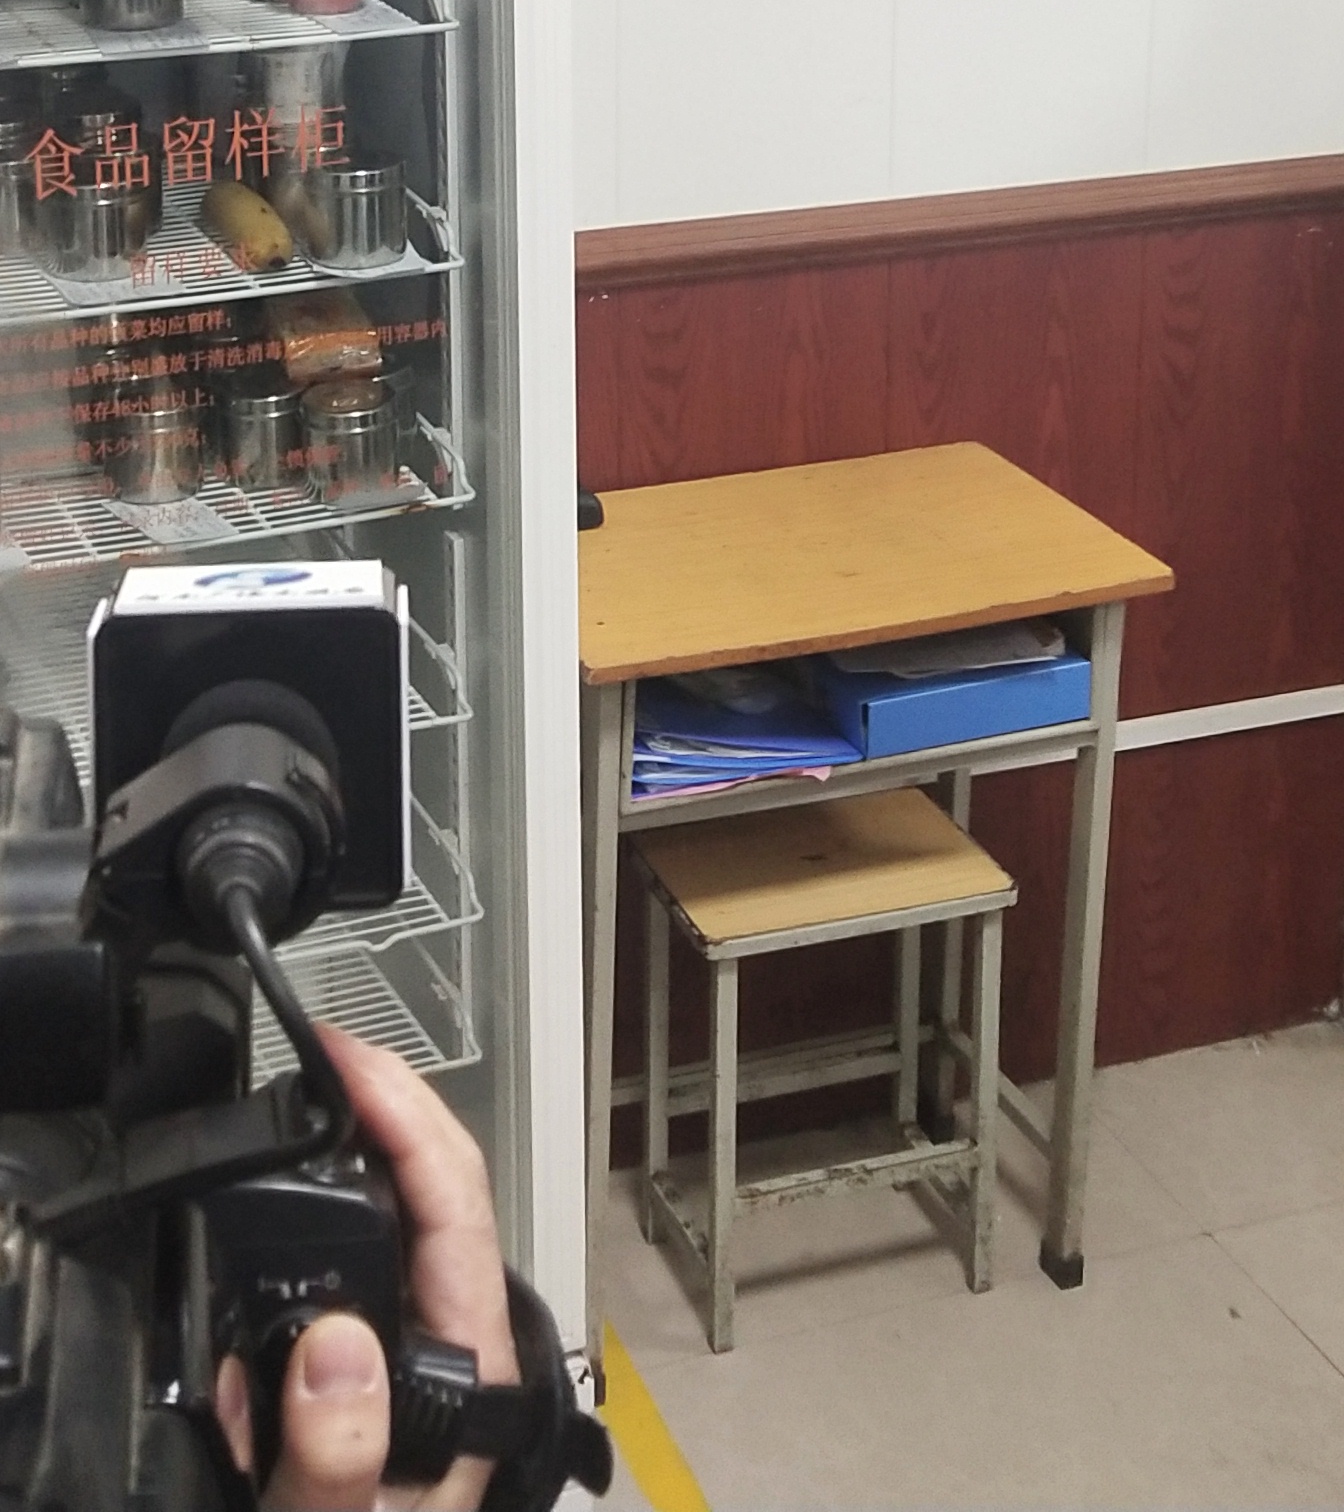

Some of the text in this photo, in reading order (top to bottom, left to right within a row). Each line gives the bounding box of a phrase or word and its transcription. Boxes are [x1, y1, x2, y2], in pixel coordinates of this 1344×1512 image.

[25, 104, 350, 201] 食品留样柜
